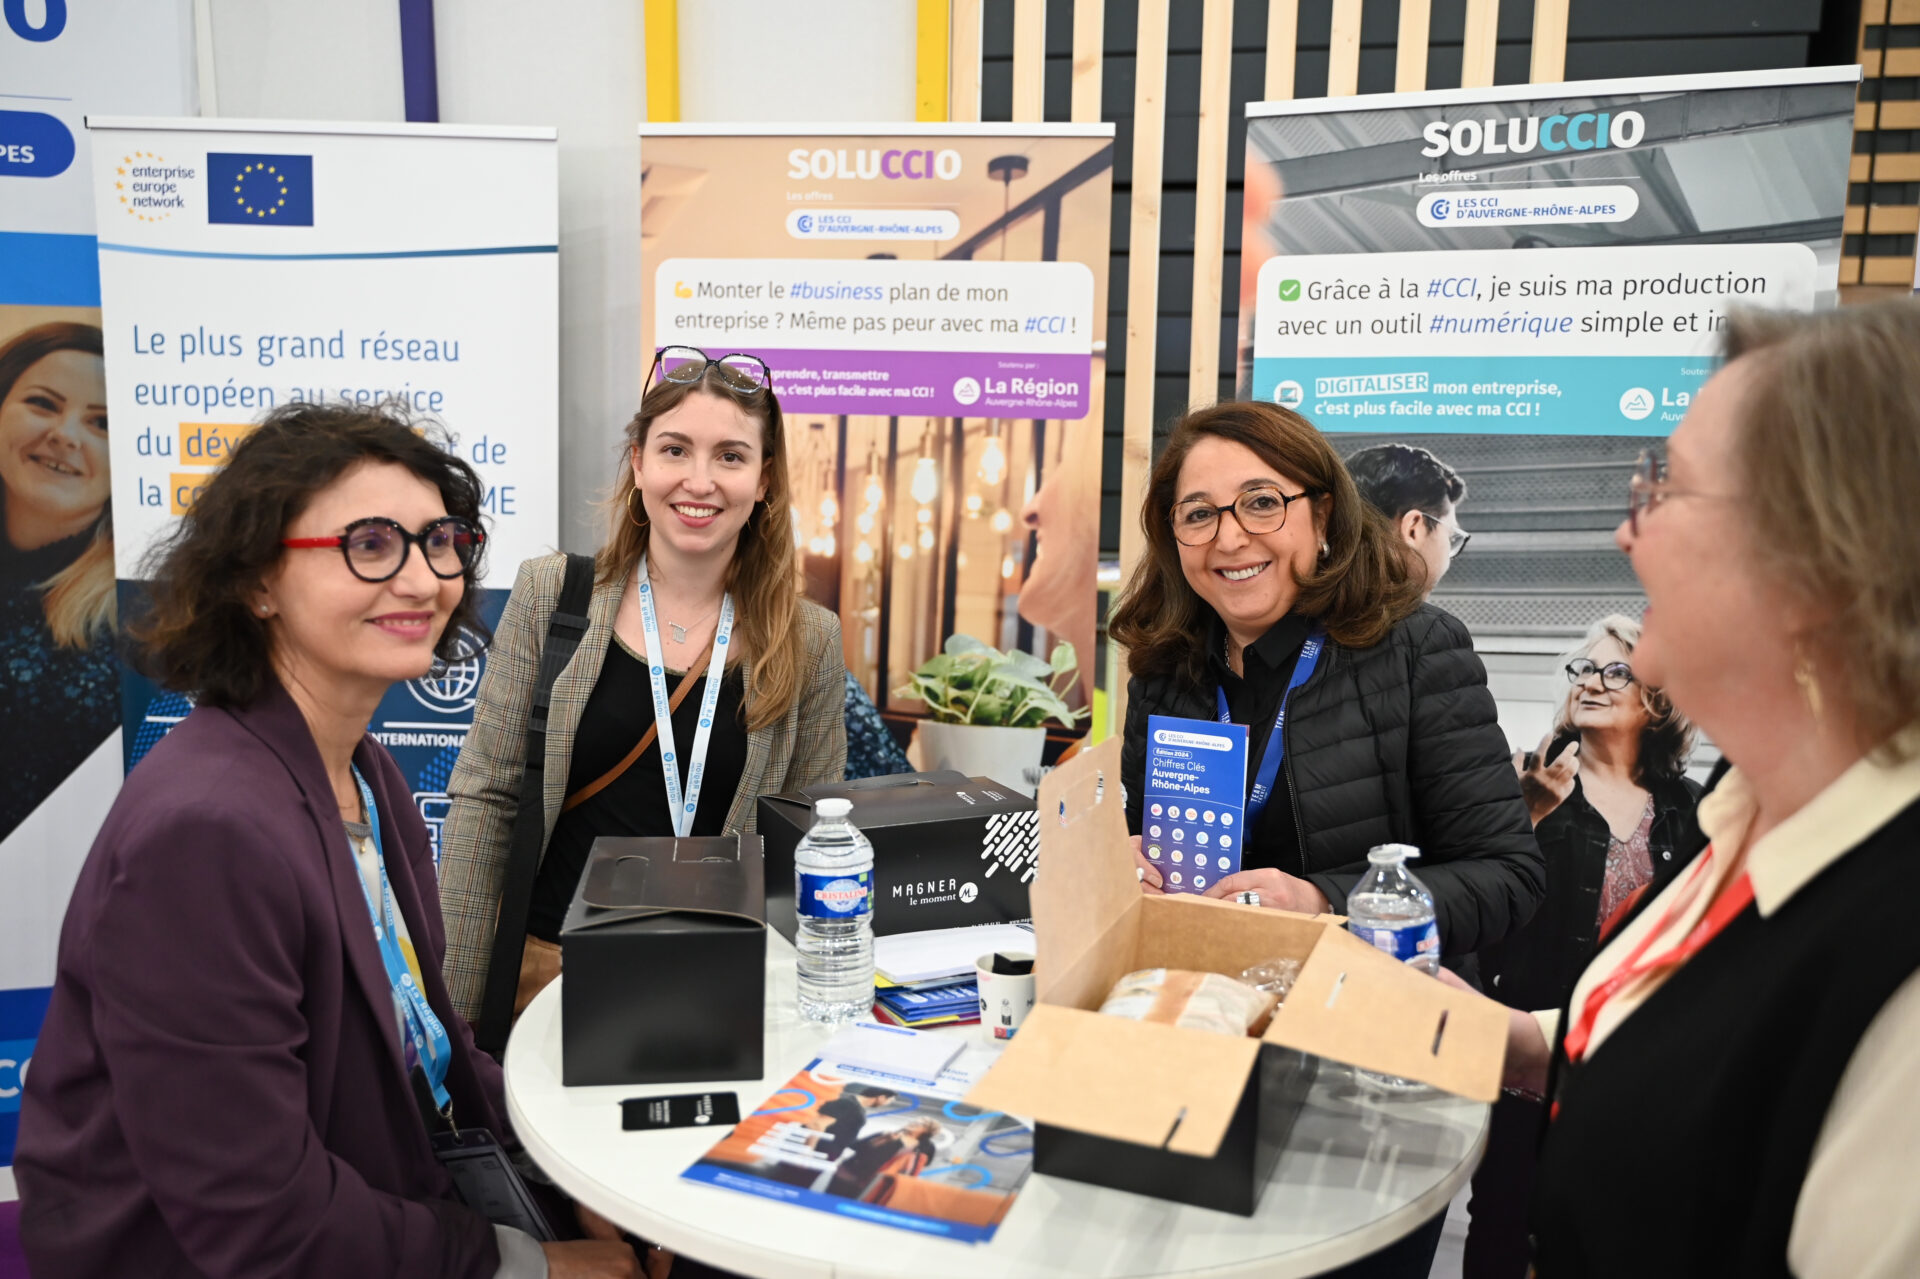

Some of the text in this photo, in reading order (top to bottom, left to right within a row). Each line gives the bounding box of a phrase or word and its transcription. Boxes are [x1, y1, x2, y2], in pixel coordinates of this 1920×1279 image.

[1420, 110, 1646, 158] SOLUCCIO
[132, 165, 195, 180] enterprise
[787, 149, 962, 180] SOLUCCIO
[1418, 169, 1477, 183] Les offres
[132, 181, 177, 195] europe
[787, 190, 834, 201] Les offres
[133, 195, 185, 208] network
[1457, 198, 1498, 208] LES CCI
[818, 215, 852, 224] LES CCI
[1456, 204, 1616, 219] D'AUVERGNE-RHÔNE-ALPES
[697, 280, 1008, 304] Monter le #business plan de mon
[1308, 278, 1370, 300] Grâce
[1378, 277, 1390, 299] à
[1400, 278, 1418, 299] la
[1489, 275, 1511, 302] je
[1519, 274, 1567, 296] suis
[1576, 278, 1612, 296] ma
[1623, 271, 1766, 301] production
[675, 310, 1076, 334] entreprise ? Même pas peur avec ma #CCI !
[1278, 319, 1327, 335] avec
[1336, 319, 1362, 335] un
[1371, 312, 1422, 335] outil
[1429, 311, 1573, 338] #numérique
[1581, 310, 1664, 338] simple
[1673, 312, 1699, 332] et
[133, 324, 460, 366] Le plus grand réseau
[822, 368, 889, 381] transmettre
[788, 384, 811, 396] c'est
[814, 385, 837, 398] plus
[838, 385, 866, 397] facile
[867, 387, 893, 397] avec
[894, 387, 911, 397] ma
[912, 386, 929, 398] CCI
[985, 377, 1079, 399] La Région
[1316, 374, 1562, 398] DIGITALISER mon entreprise,
[135, 377, 274, 414] européen
[340, 382, 443, 412] service
[985, 397, 1078, 408] Auvergne-Rhône-Alpes
[1661, 387, 1690, 407] La
[1315, 400, 1540, 418] c'est plus facile avec ma CCI !
[136, 427, 172, 456] du
[472, 435, 507, 464] de
[139, 477, 162, 506] la
[1301, 640, 1313, 658] TEAM
[1152, 757, 1206, 772] Chiffres Clés
[1152, 767, 1199, 781] Auvergne-
[1151, 778, 1210, 794] Rhône-Alpes
[1250, 783, 1263, 802] TEAM
[892, 878, 957, 898] MAGNER
[909, 893, 957, 906] le moment
